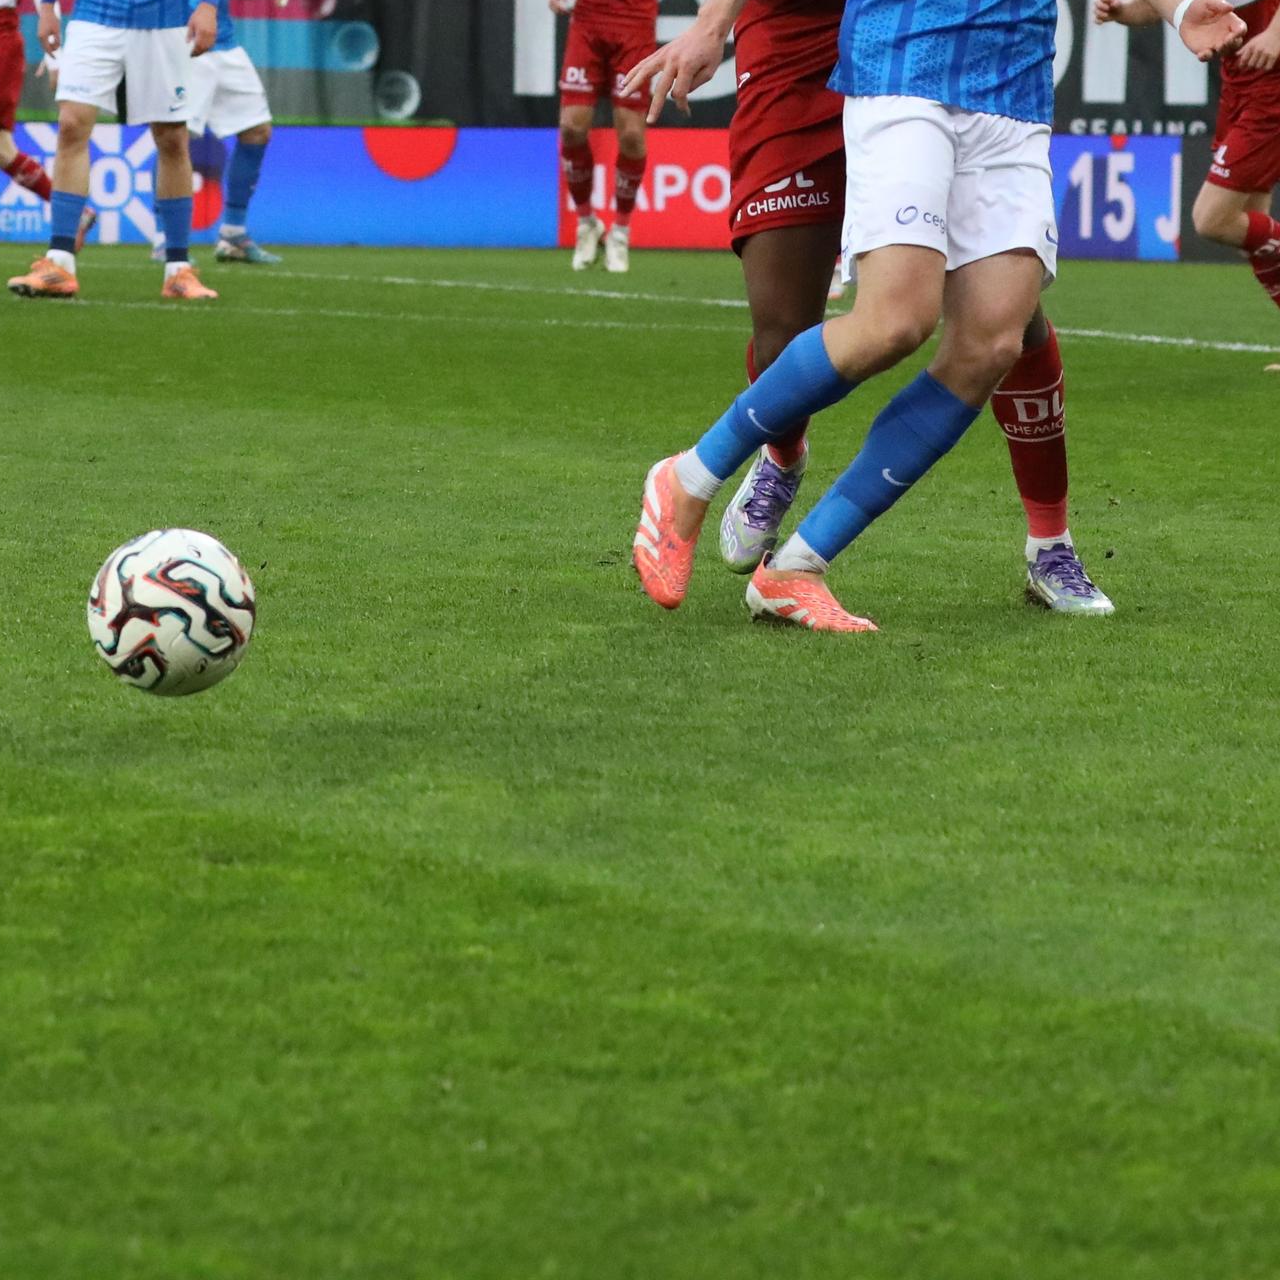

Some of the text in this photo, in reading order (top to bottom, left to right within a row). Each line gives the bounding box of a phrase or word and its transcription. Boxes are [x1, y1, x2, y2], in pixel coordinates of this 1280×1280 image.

[565, 66, 588, 83] DL
[746, 191, 830, 217] CHEMICALS
[1070, 152, 1136, 244] 15
